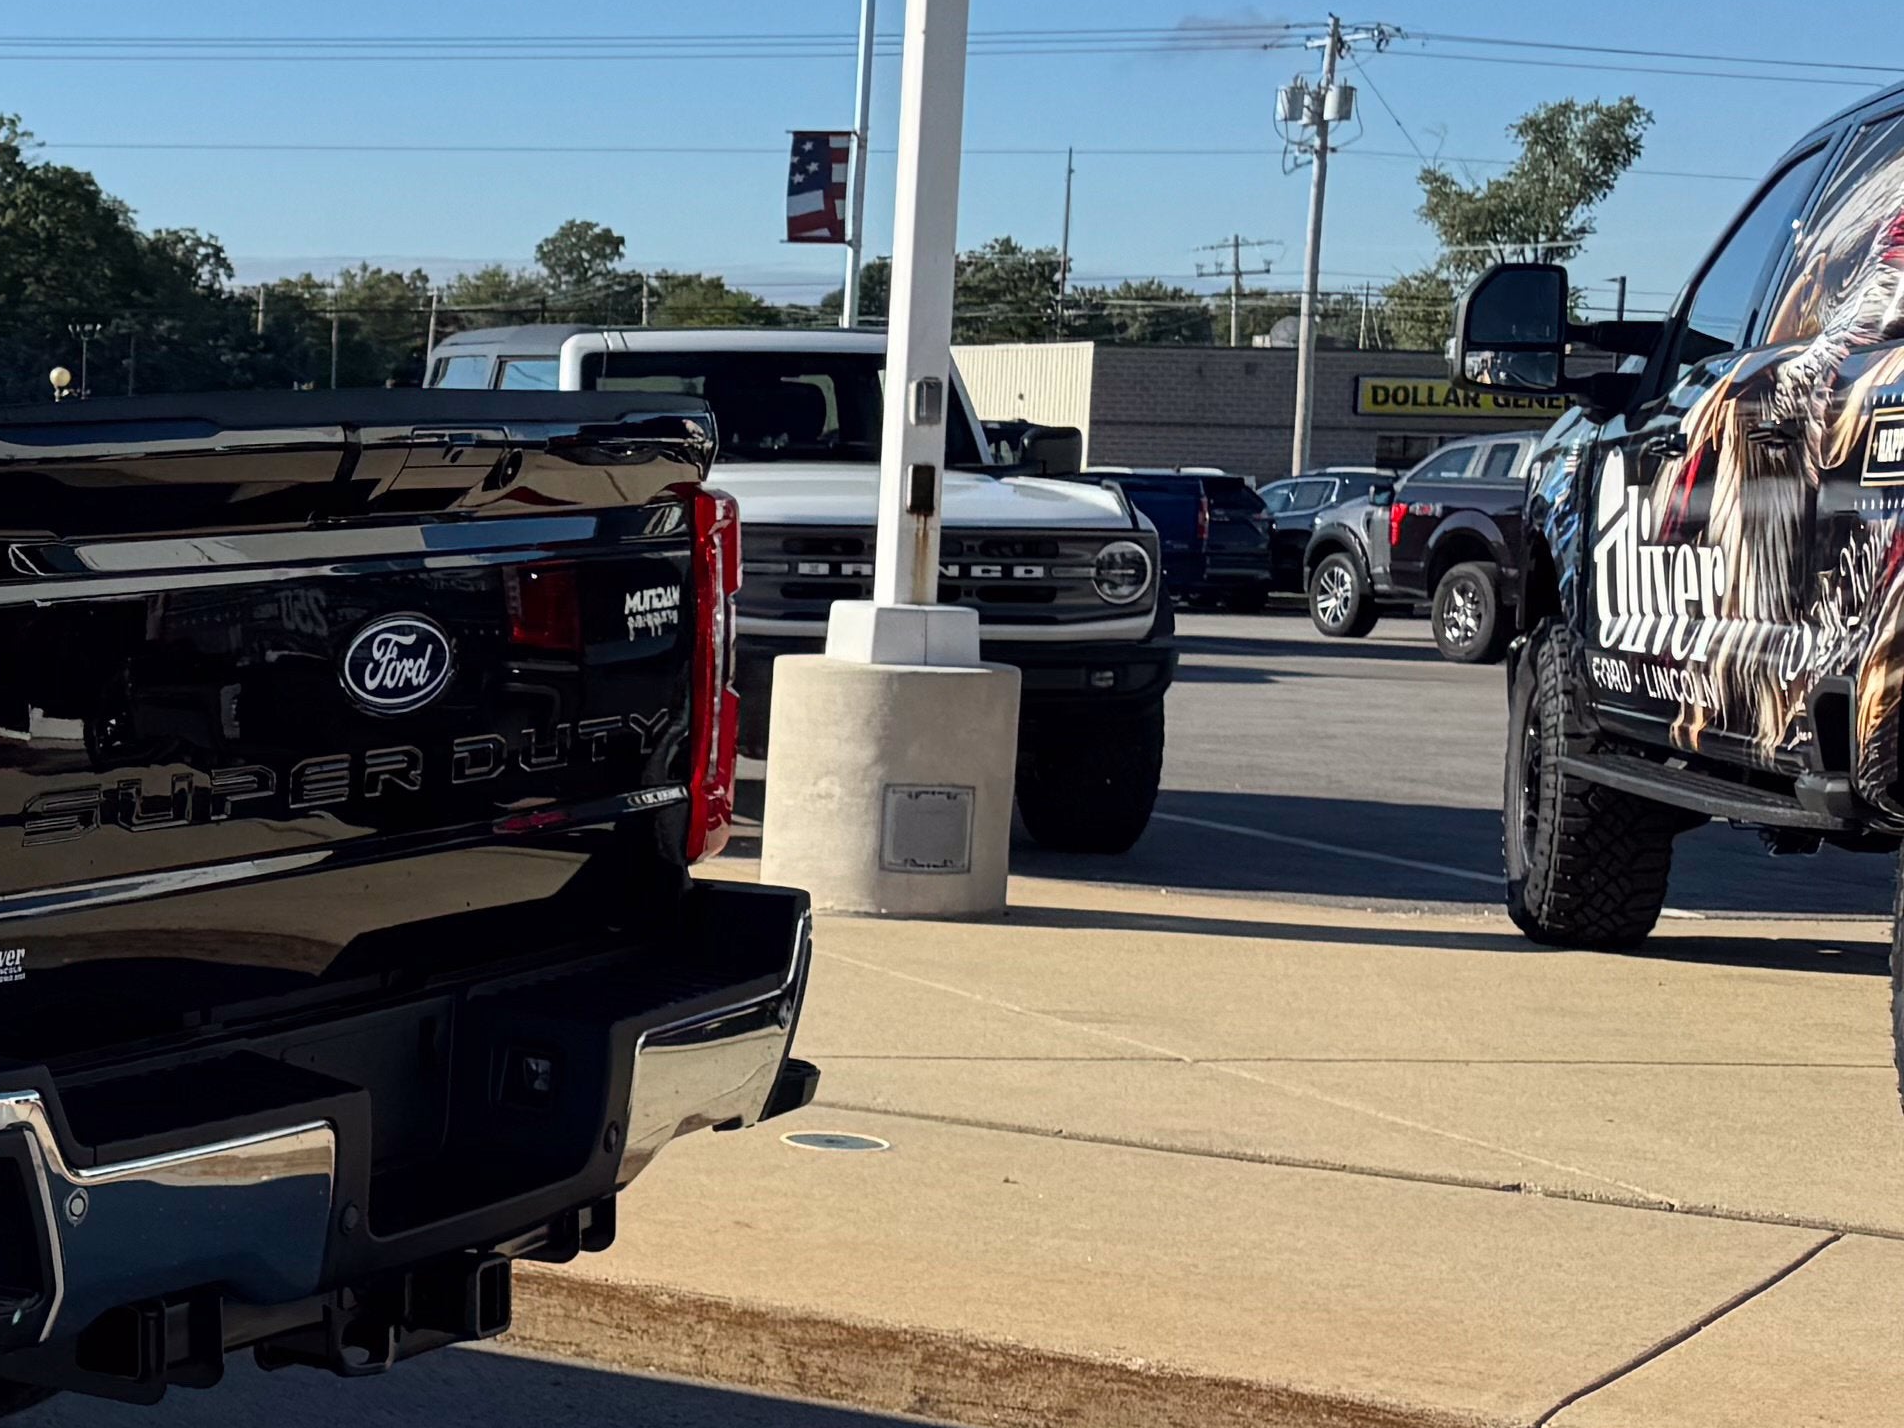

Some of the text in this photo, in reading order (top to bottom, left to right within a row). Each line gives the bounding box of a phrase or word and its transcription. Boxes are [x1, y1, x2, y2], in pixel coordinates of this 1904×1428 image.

[1371, 384, 1577, 409] DOLLAR GENE
[797, 562, 1044, 578] BRNCO
[1594, 445, 1725, 662] Oliver
[364, 632, 434, 691] Ford
[1592, 656, 1721, 710] FORD LINCOLN
[21, 708, 669, 848] SUPER DUTY
